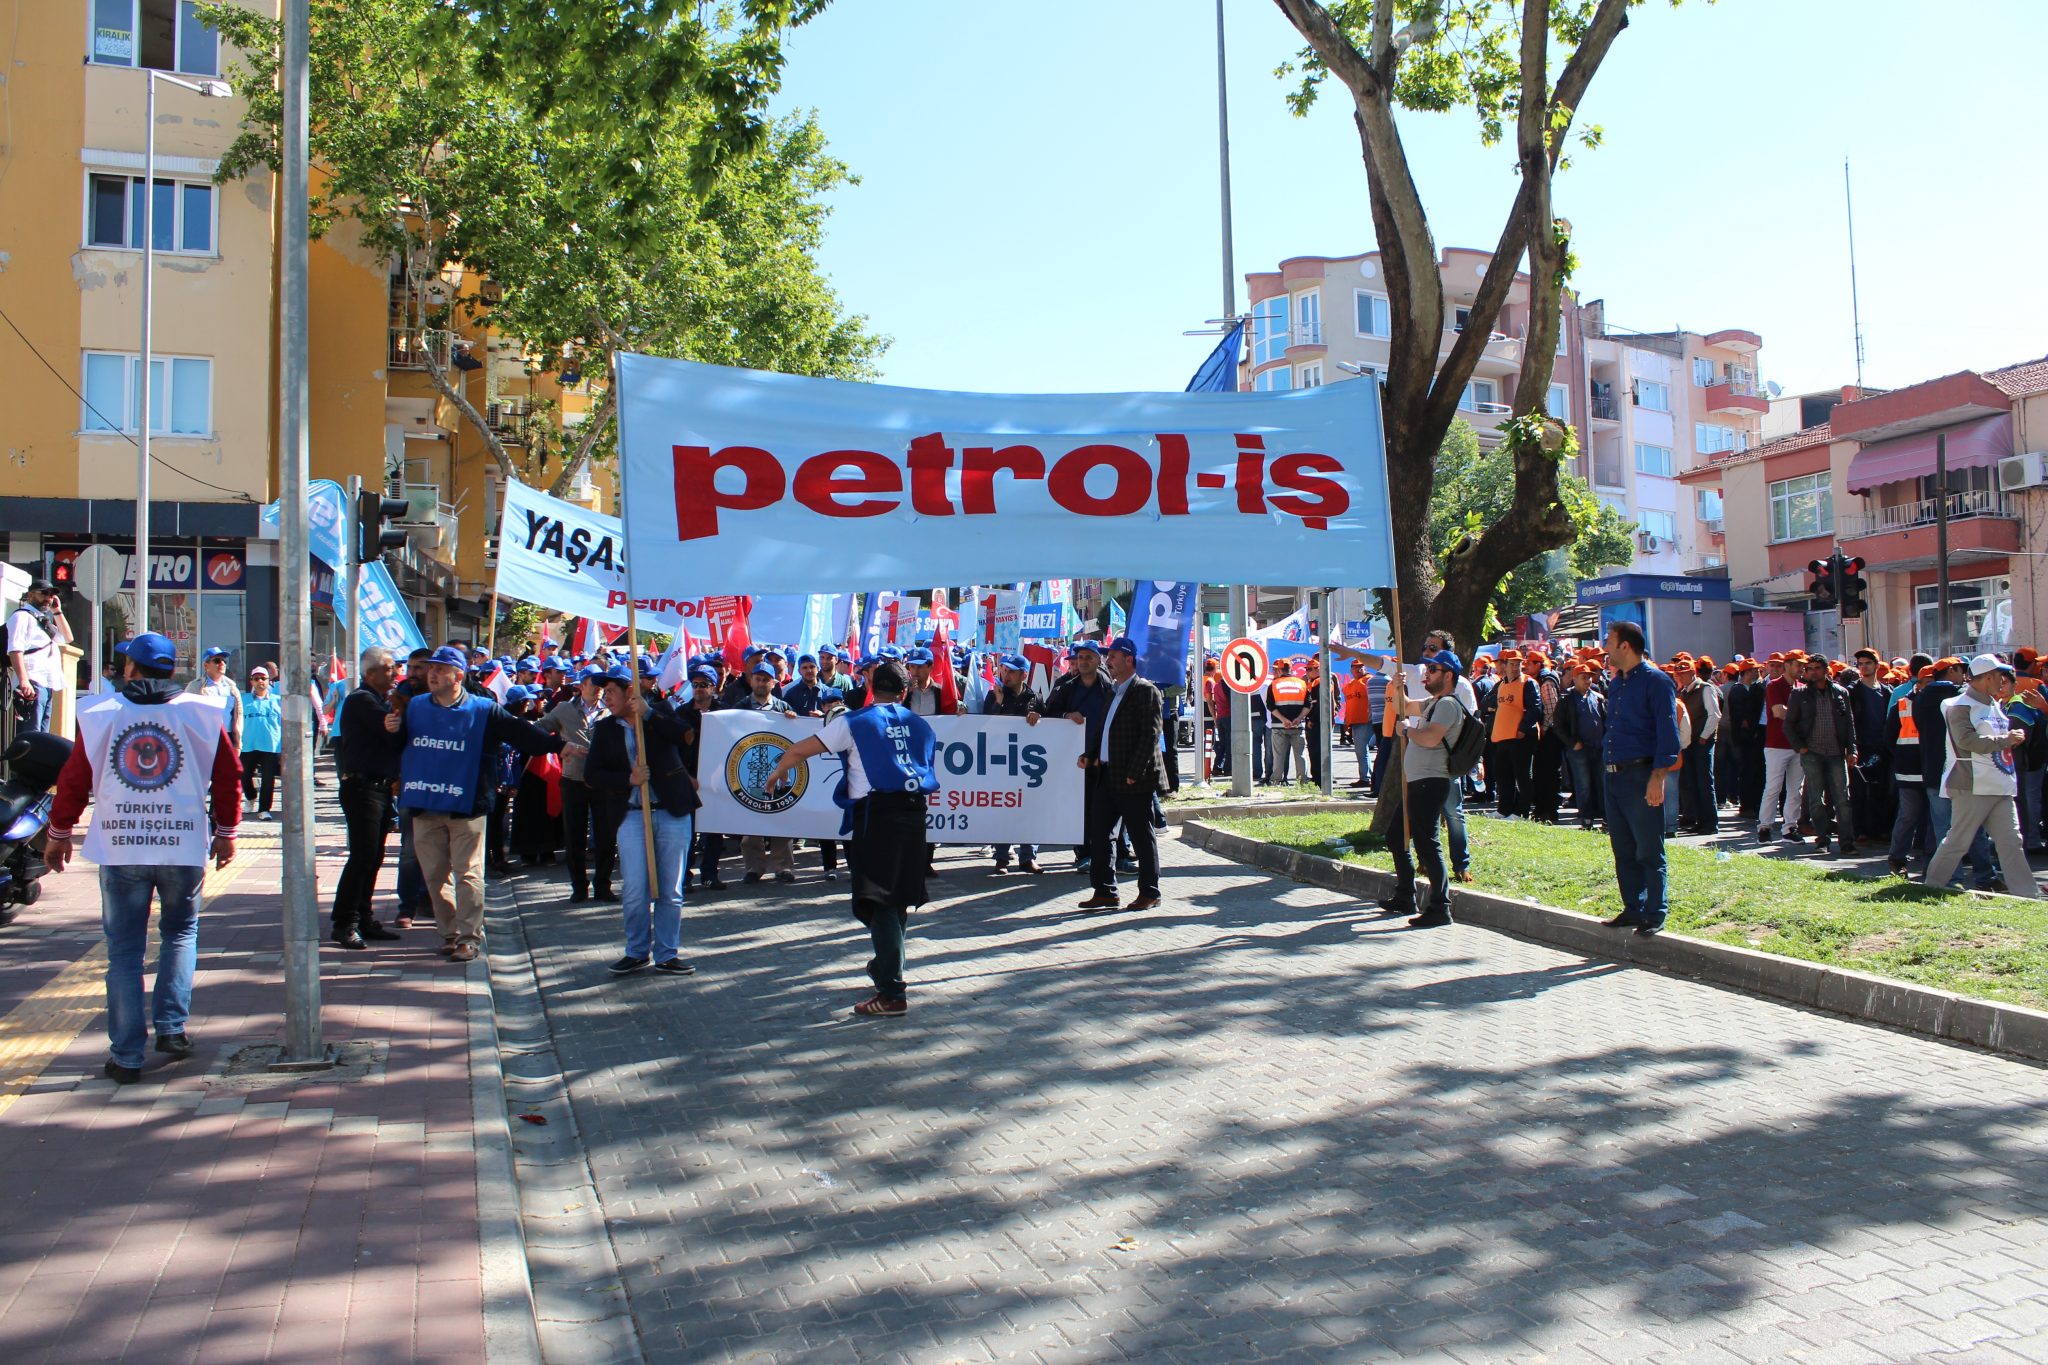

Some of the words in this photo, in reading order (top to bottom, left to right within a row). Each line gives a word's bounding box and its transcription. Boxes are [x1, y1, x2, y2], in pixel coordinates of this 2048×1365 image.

[672, 431, 1350, 541] petrol-iş
[526, 508, 624, 574] YAŞA
[1174, 584, 1187, 615] Türkiye
[1020, 609, 1057, 629] ERKEZİ
[886, 725, 911, 739] SEN
[412, 735, 465, 752] GÖREVLİ
[894, 739, 908, 751] Dİ
[896, 753, 912, 765] KA
[403, 779, 464, 797] petrol-iş
[115, 801, 173, 814] TÜRKİYE
[947, 788, 1023, 810] ŞUBESİ
[140, 818, 194, 832] İŞÇİLERİ
[926, 813, 969, 830] 2013
[112, 833, 180, 846] SENDİKASI
